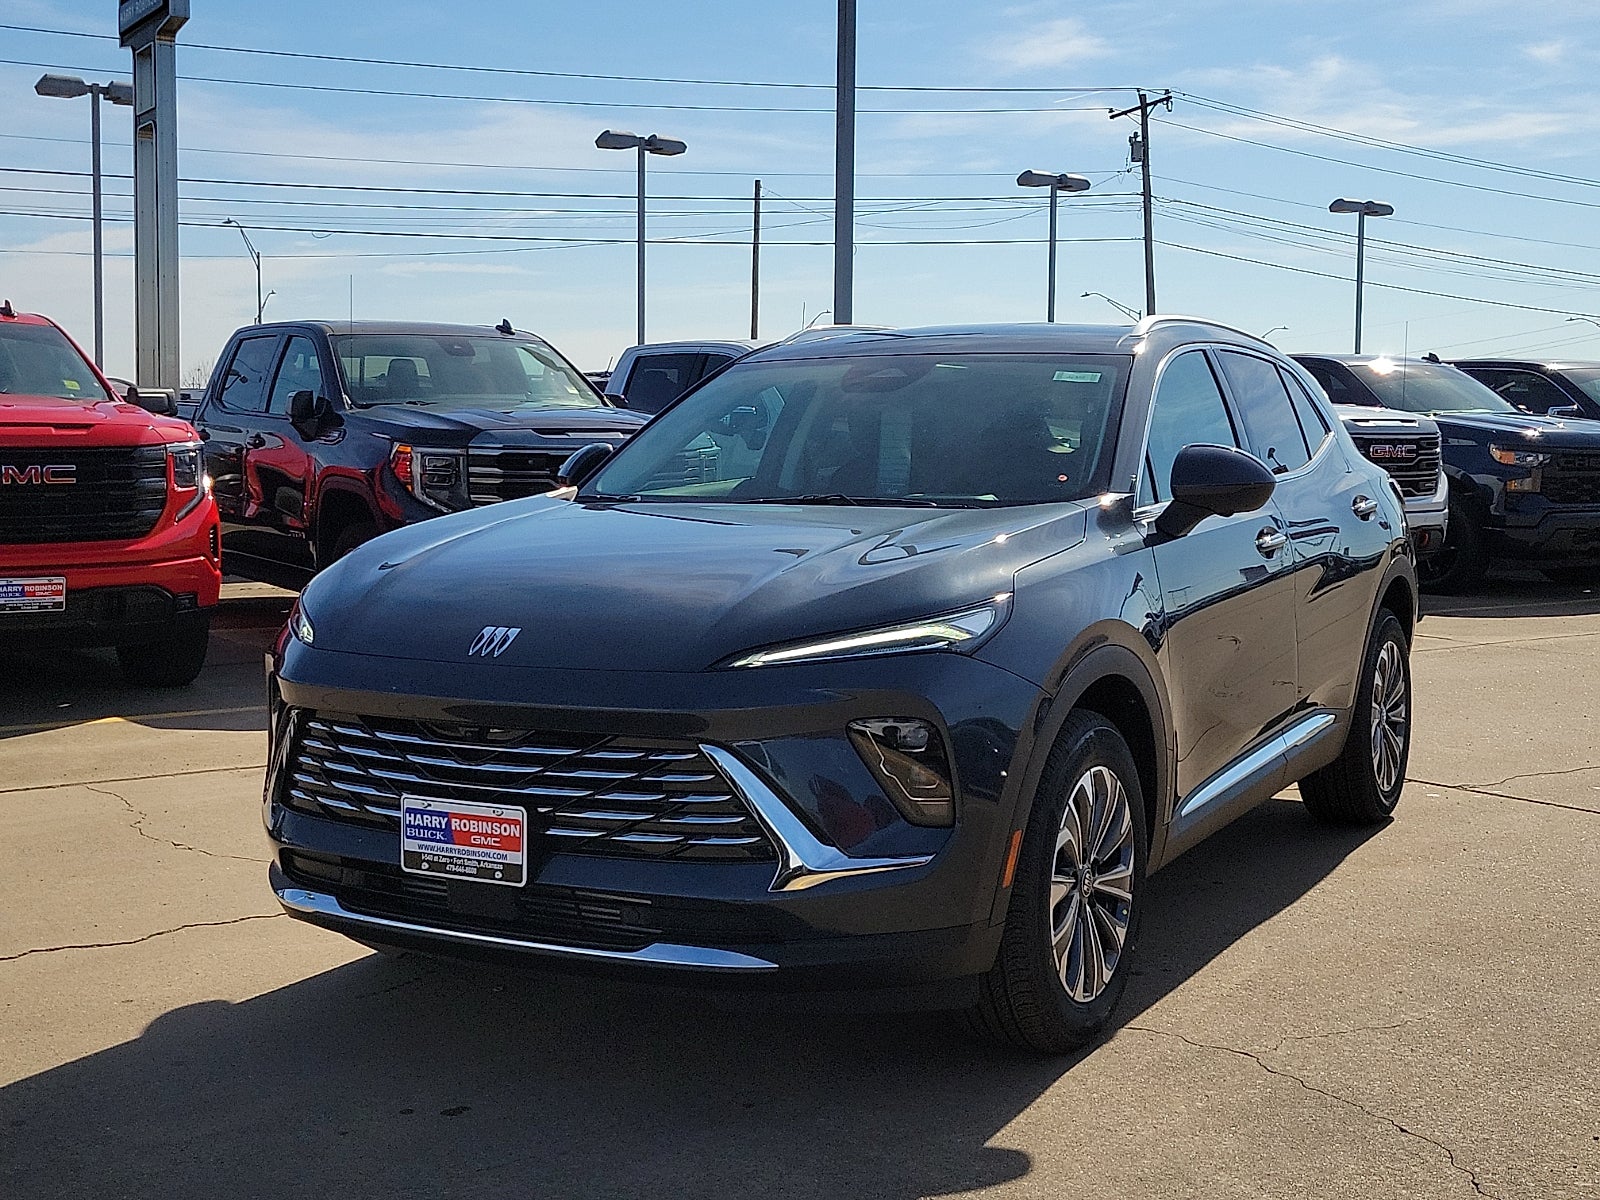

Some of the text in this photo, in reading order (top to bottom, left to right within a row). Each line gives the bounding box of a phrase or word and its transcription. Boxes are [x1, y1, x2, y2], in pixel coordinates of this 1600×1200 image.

[1370, 444, 1417, 458] GMC
[0, 464, 77, 485] MC
[405, 812, 521, 838] HARRY ROBINSON
[406, 827, 445, 840] BUICK
[470, 835, 502, 847] GMC
[417, 843, 508, 861] WWW.HARRYROBINSON.COM
